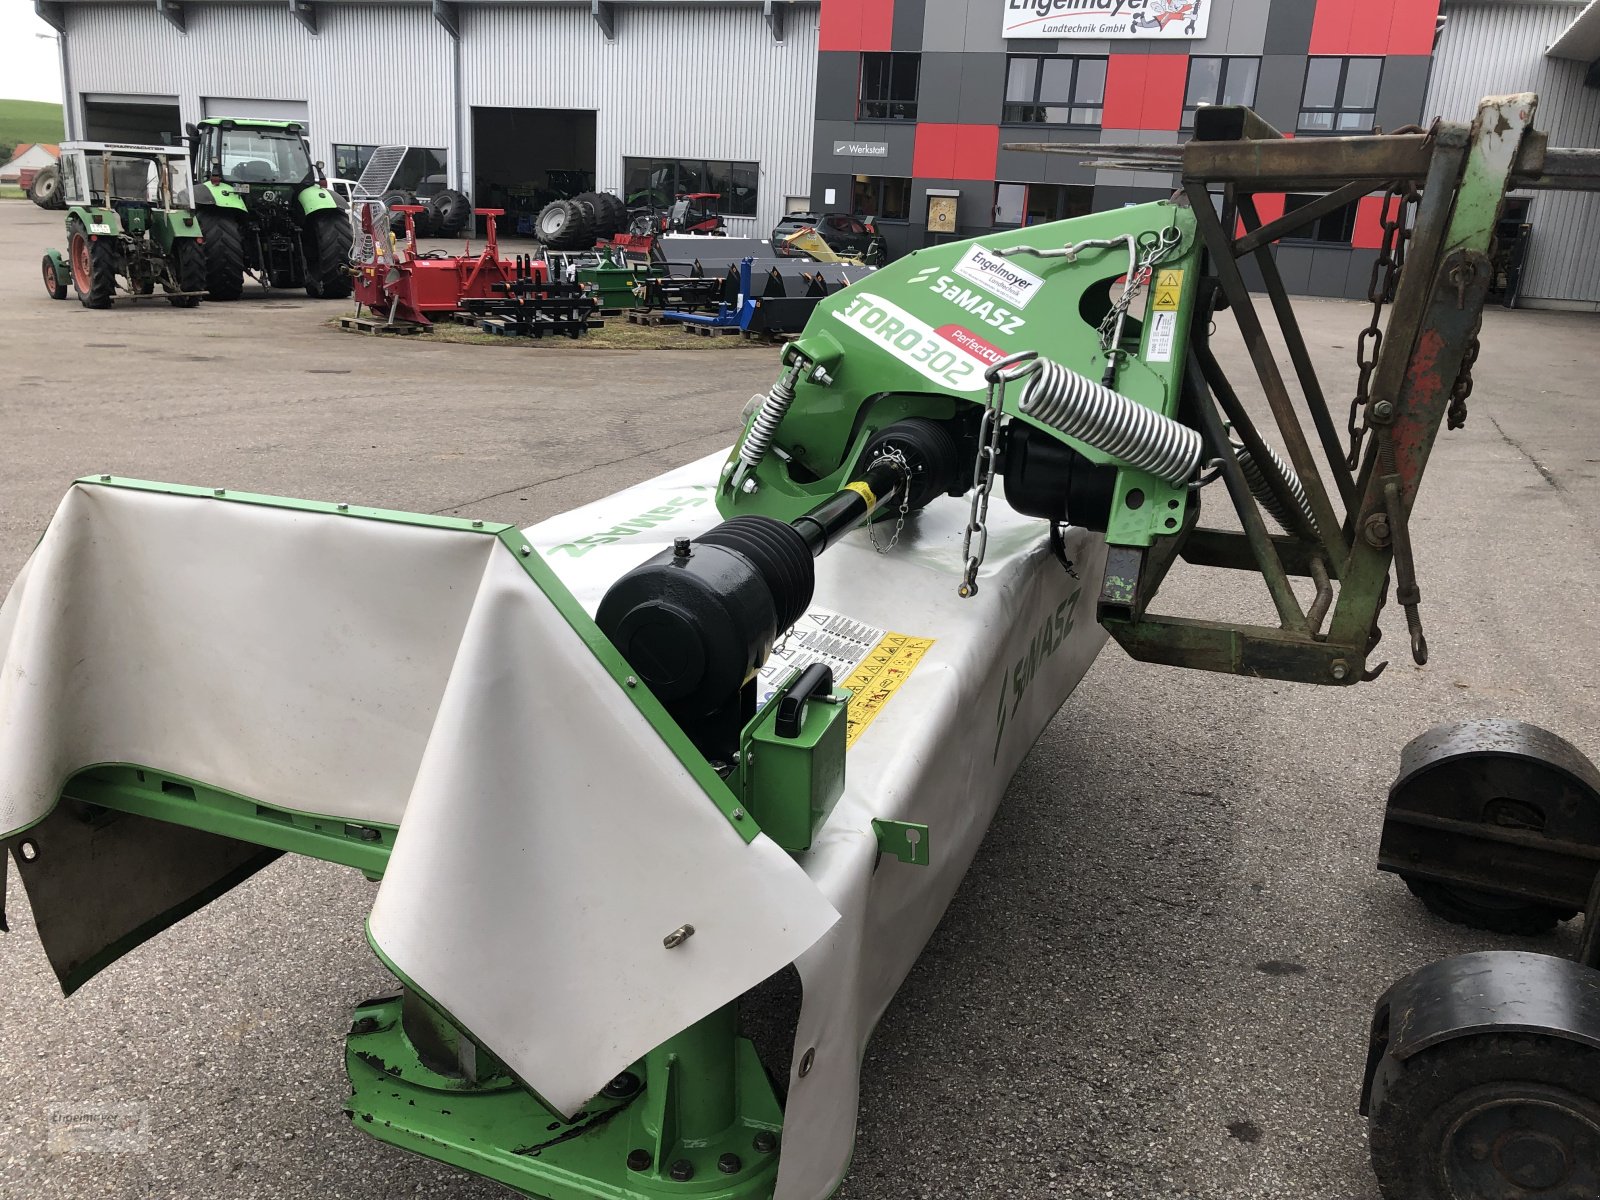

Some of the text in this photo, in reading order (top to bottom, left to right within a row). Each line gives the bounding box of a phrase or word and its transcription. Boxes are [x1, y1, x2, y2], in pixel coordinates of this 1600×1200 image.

[1042, 24, 1126, 33] Landtechnik GmbH
[849, 143, 885, 154] Werkstatt
[971, 251, 1033, 289] Engelmayer
[928, 275, 1026, 335] SaMASZ
